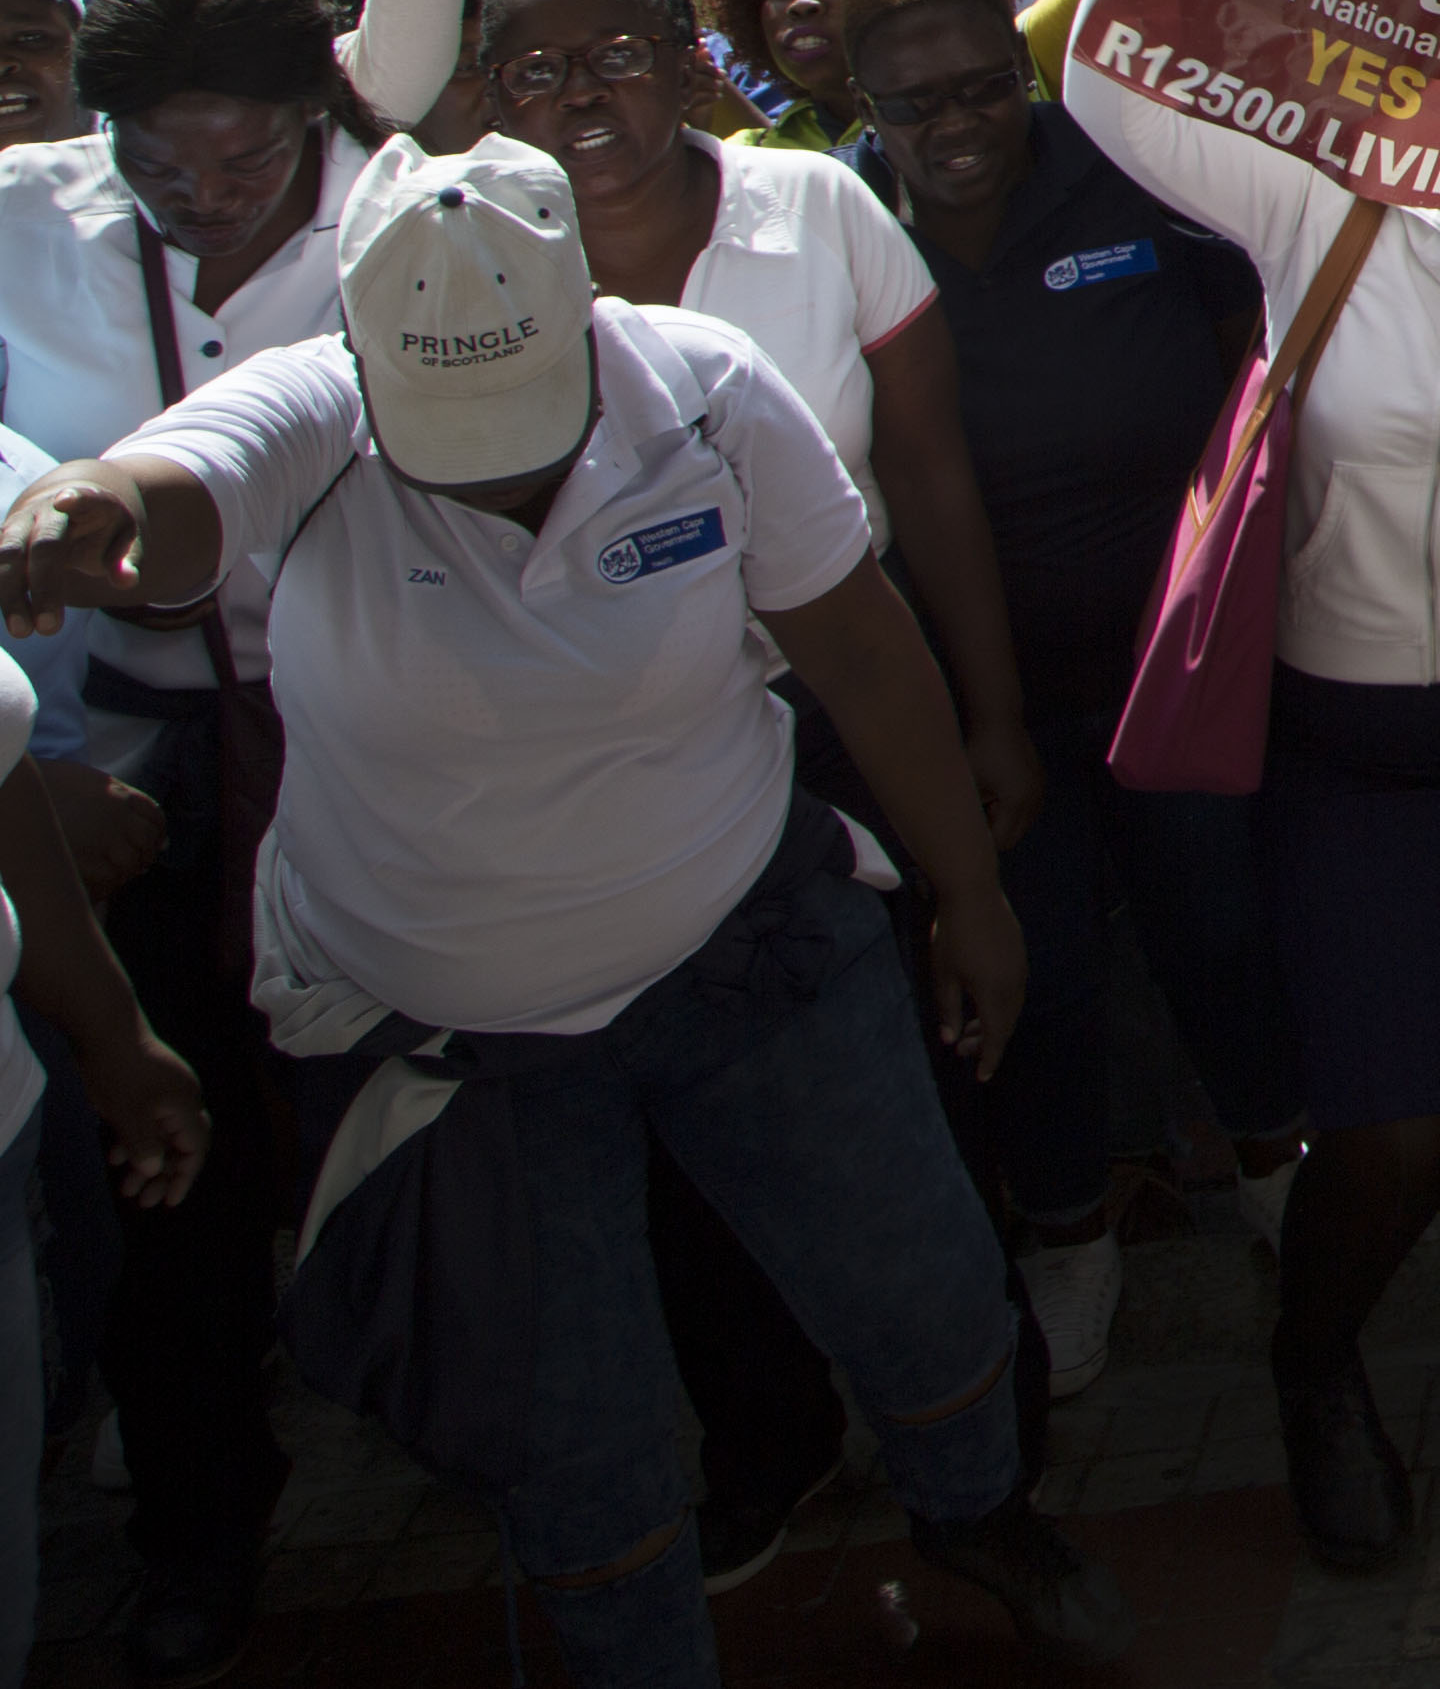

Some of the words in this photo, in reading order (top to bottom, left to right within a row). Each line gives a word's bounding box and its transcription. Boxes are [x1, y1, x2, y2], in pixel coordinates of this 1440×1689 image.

[1093, 19, 1307, 148] R12500
[1304, 28, 1426, 123] YES
[401, 317, 540, 357] PRINGLE
[421, 356, 440, 368] OF
[441, 343, 525, 369] SCOTLAND
[408, 568, 447, 586] ZAN
